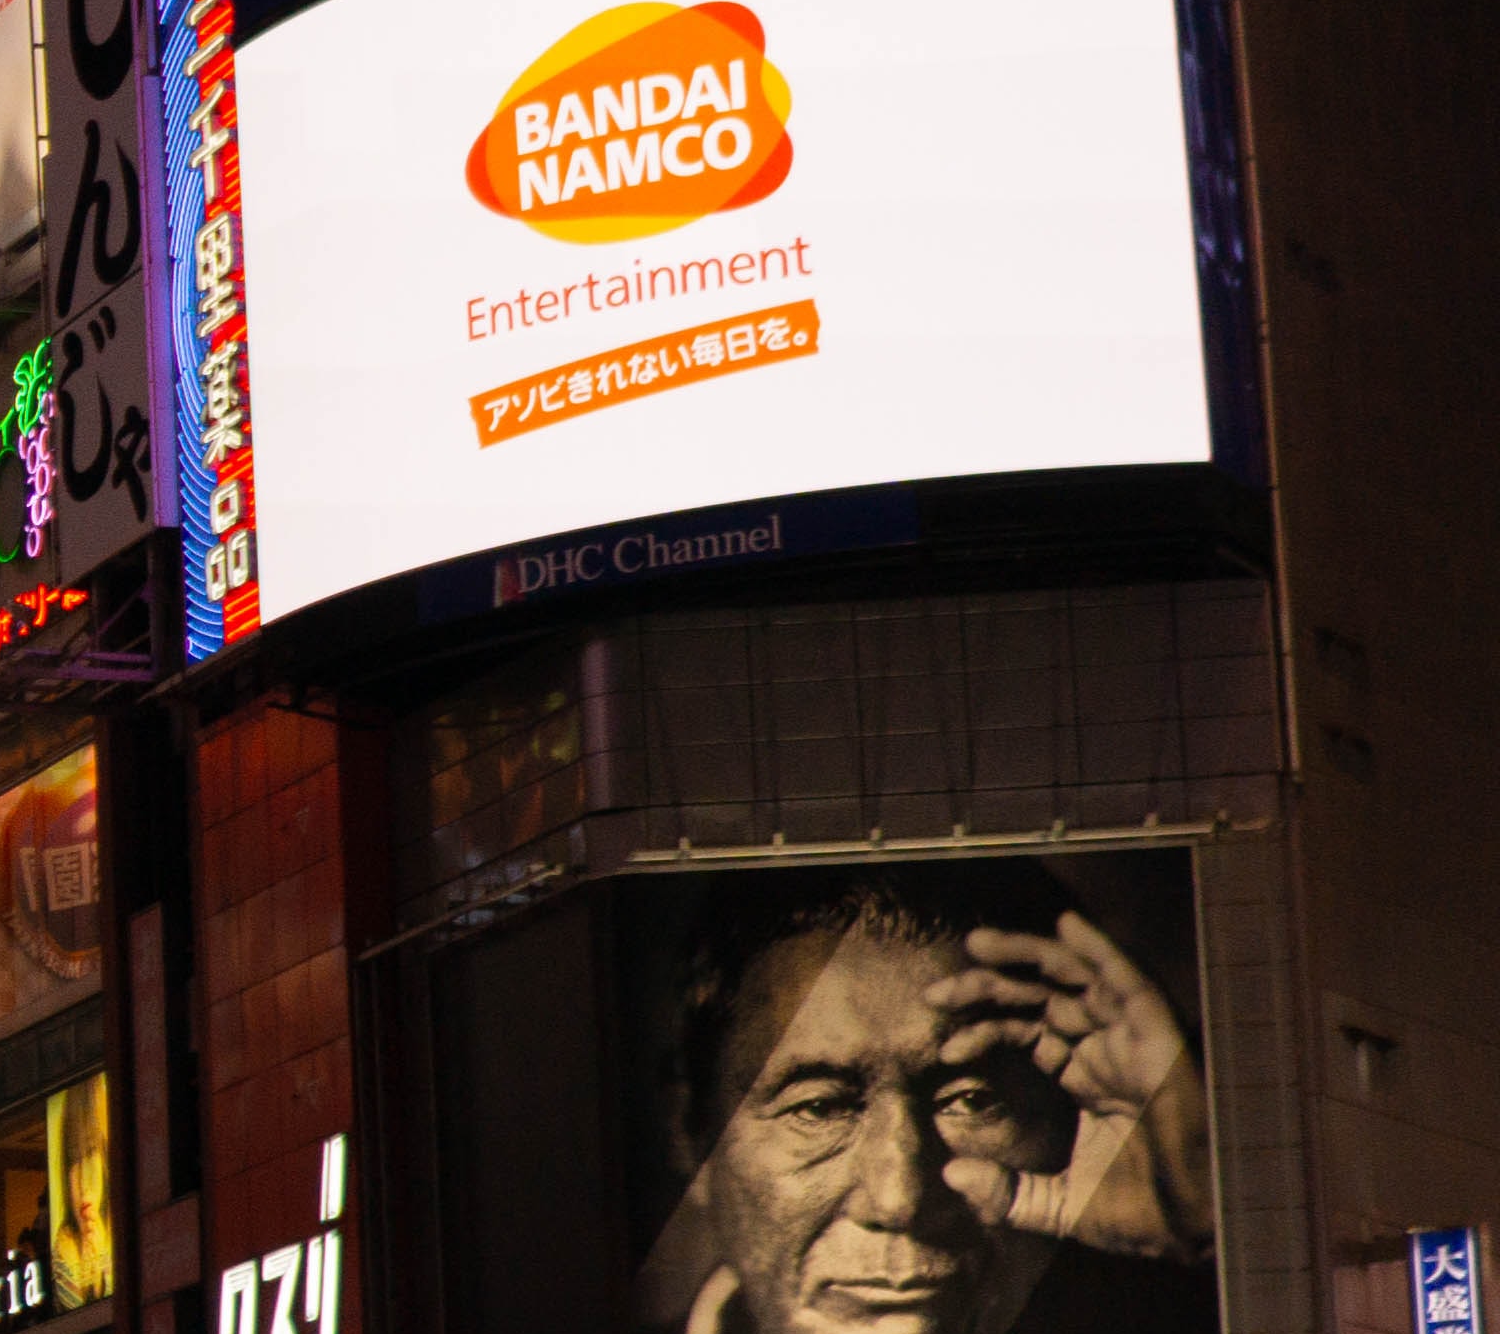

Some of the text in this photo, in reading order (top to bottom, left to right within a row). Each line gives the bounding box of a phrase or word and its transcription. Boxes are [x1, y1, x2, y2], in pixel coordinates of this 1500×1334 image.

[512, 58, 748, 156] BANDAI
[518, 117, 754, 211] NAMCO
[467, 235, 813, 342] Entertainment
[482, 314, 809, 431] アソビきれない毎日を。
[517, 514, 784, 595] DHC Channel
